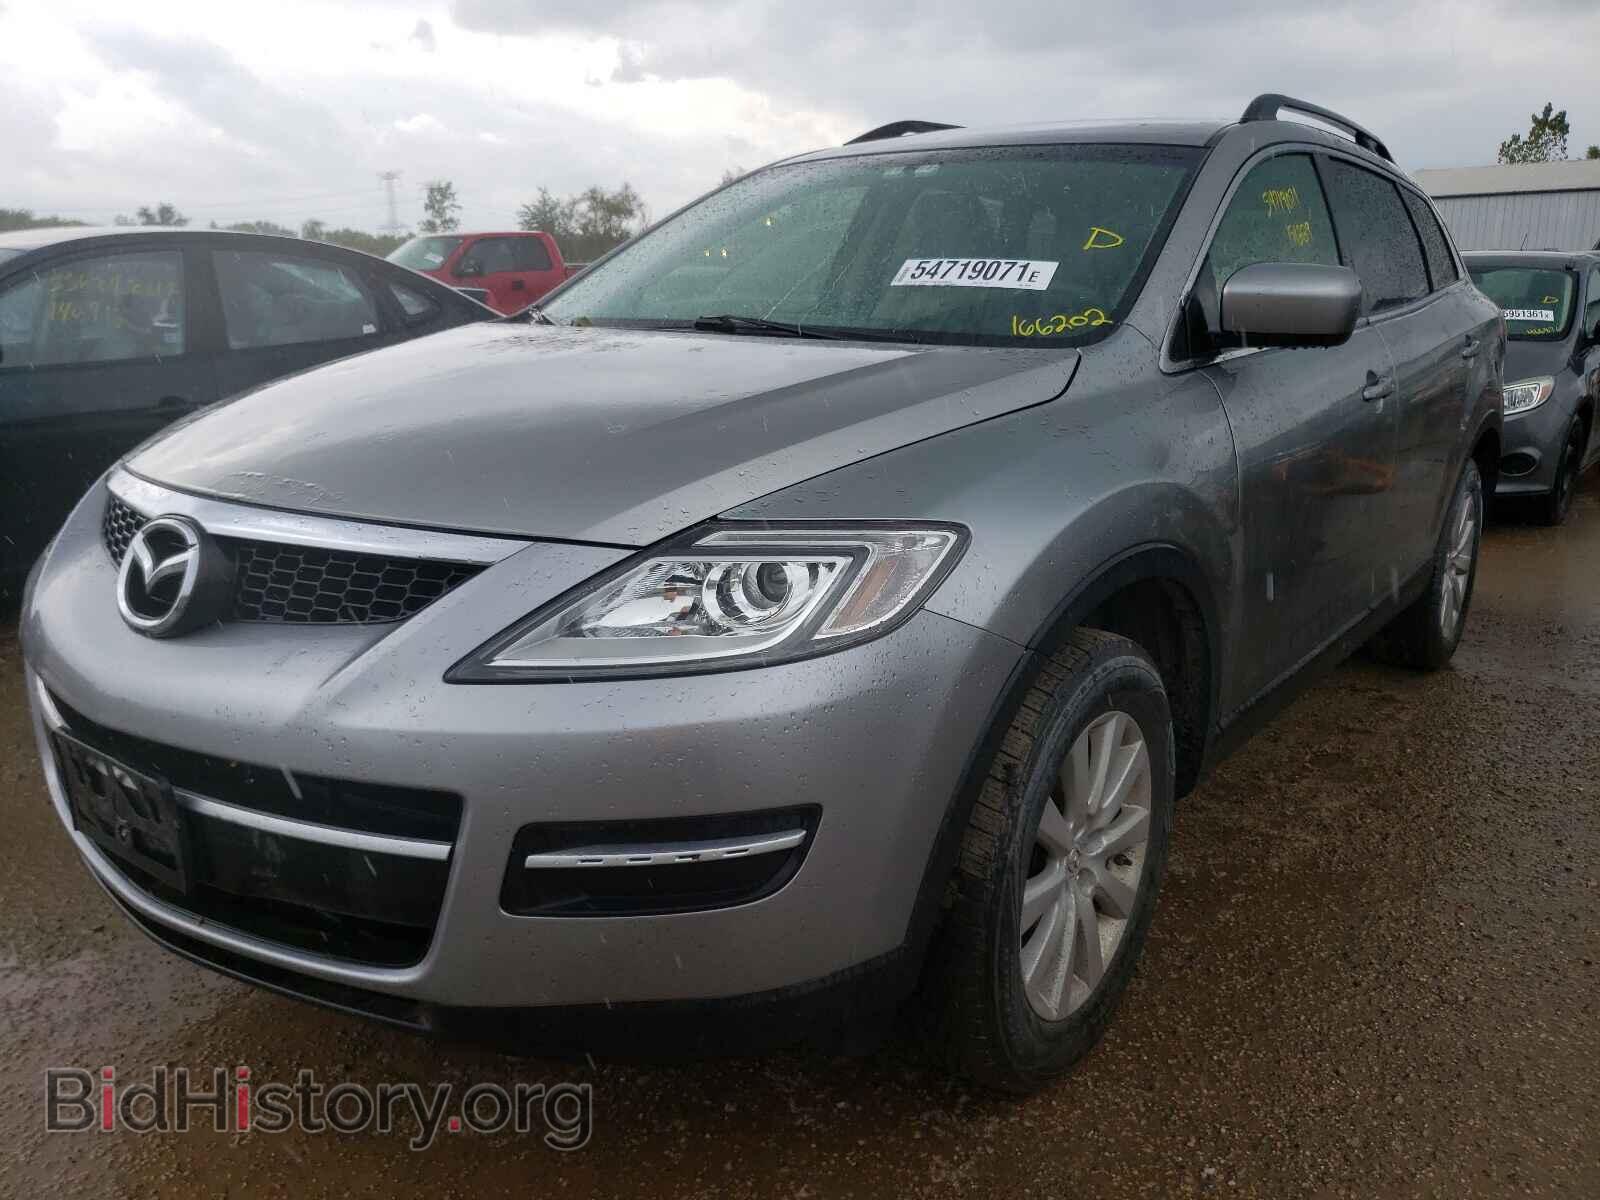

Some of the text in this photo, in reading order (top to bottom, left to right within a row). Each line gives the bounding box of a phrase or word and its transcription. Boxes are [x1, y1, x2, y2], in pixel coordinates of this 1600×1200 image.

[1083, 226, 1125, 251] D
[910, 260, 1031, 281] 54719071
[1029, 270, 1041, 283] E
[1542, 296, 1559, 304] D
[1011, 308, 1112, 336] 166202
